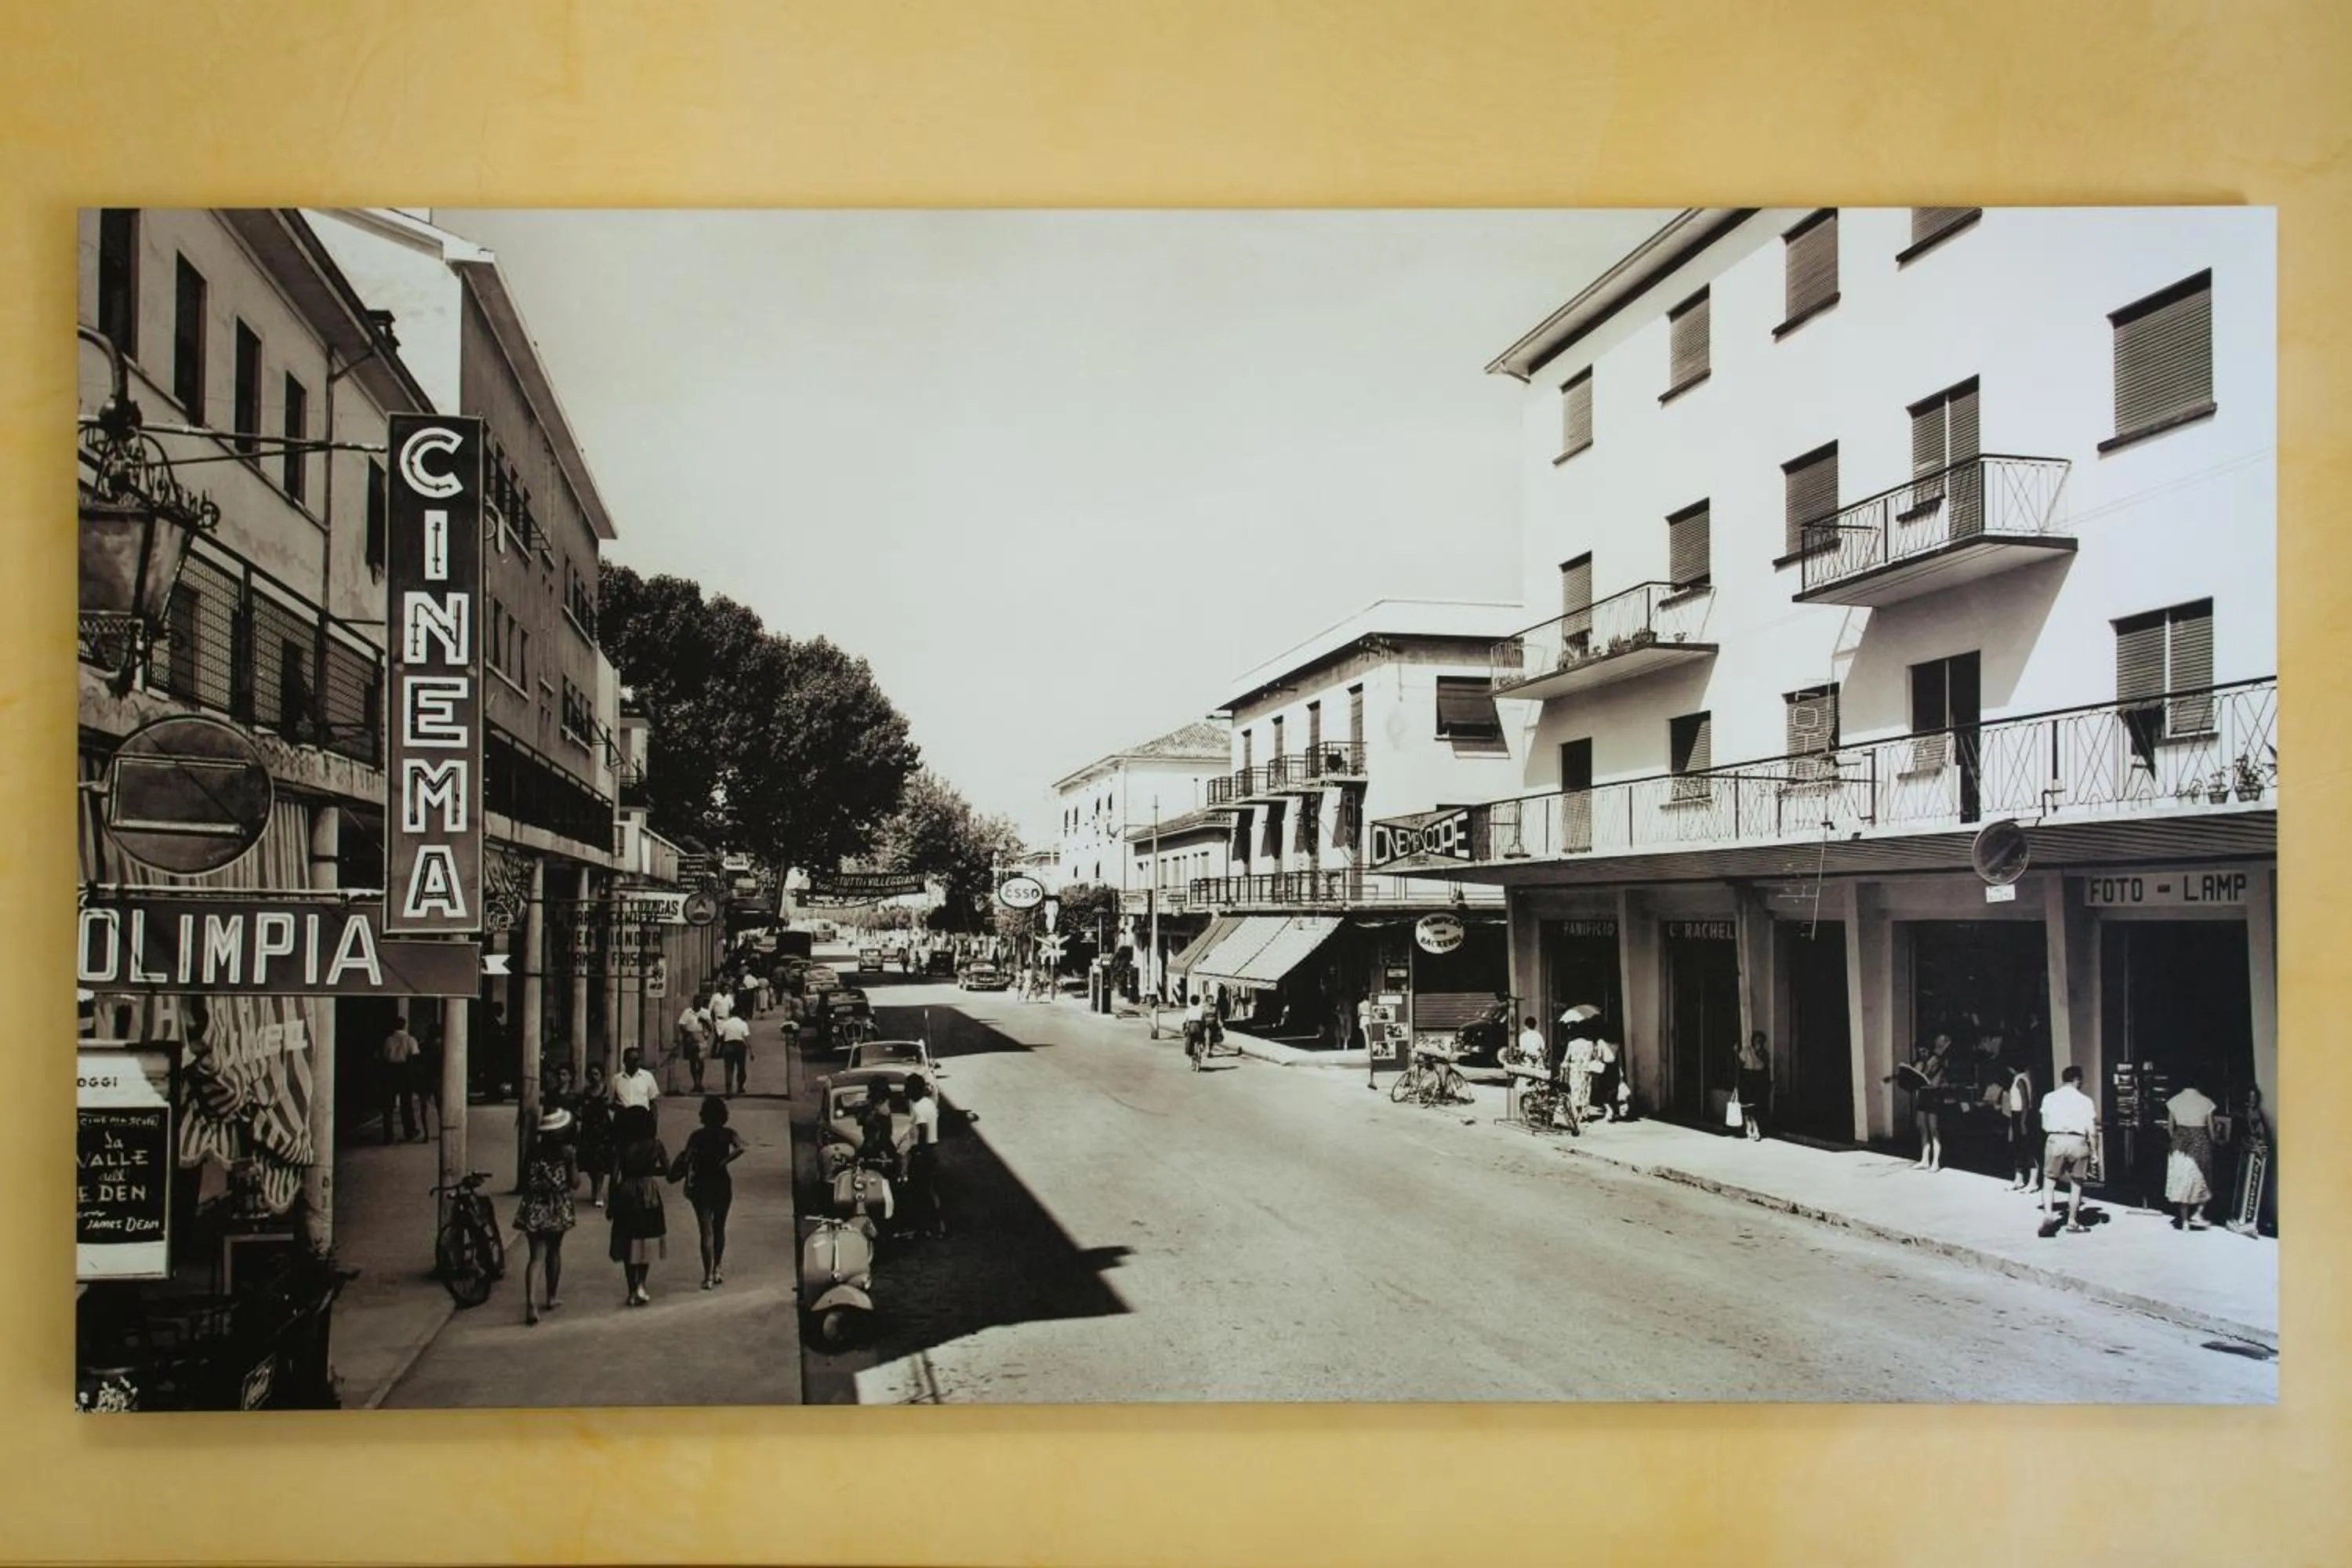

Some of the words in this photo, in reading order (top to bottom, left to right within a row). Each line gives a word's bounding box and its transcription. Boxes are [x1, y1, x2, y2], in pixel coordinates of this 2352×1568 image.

[399, 426, 470, 919] CINEMA
[2089, 877, 2143, 903] FOTO
[2183, 873, 2247, 902] LAMP
[77, 908, 383, 985] OLIMPIA
[77, 1150, 149, 1168] VALLE
